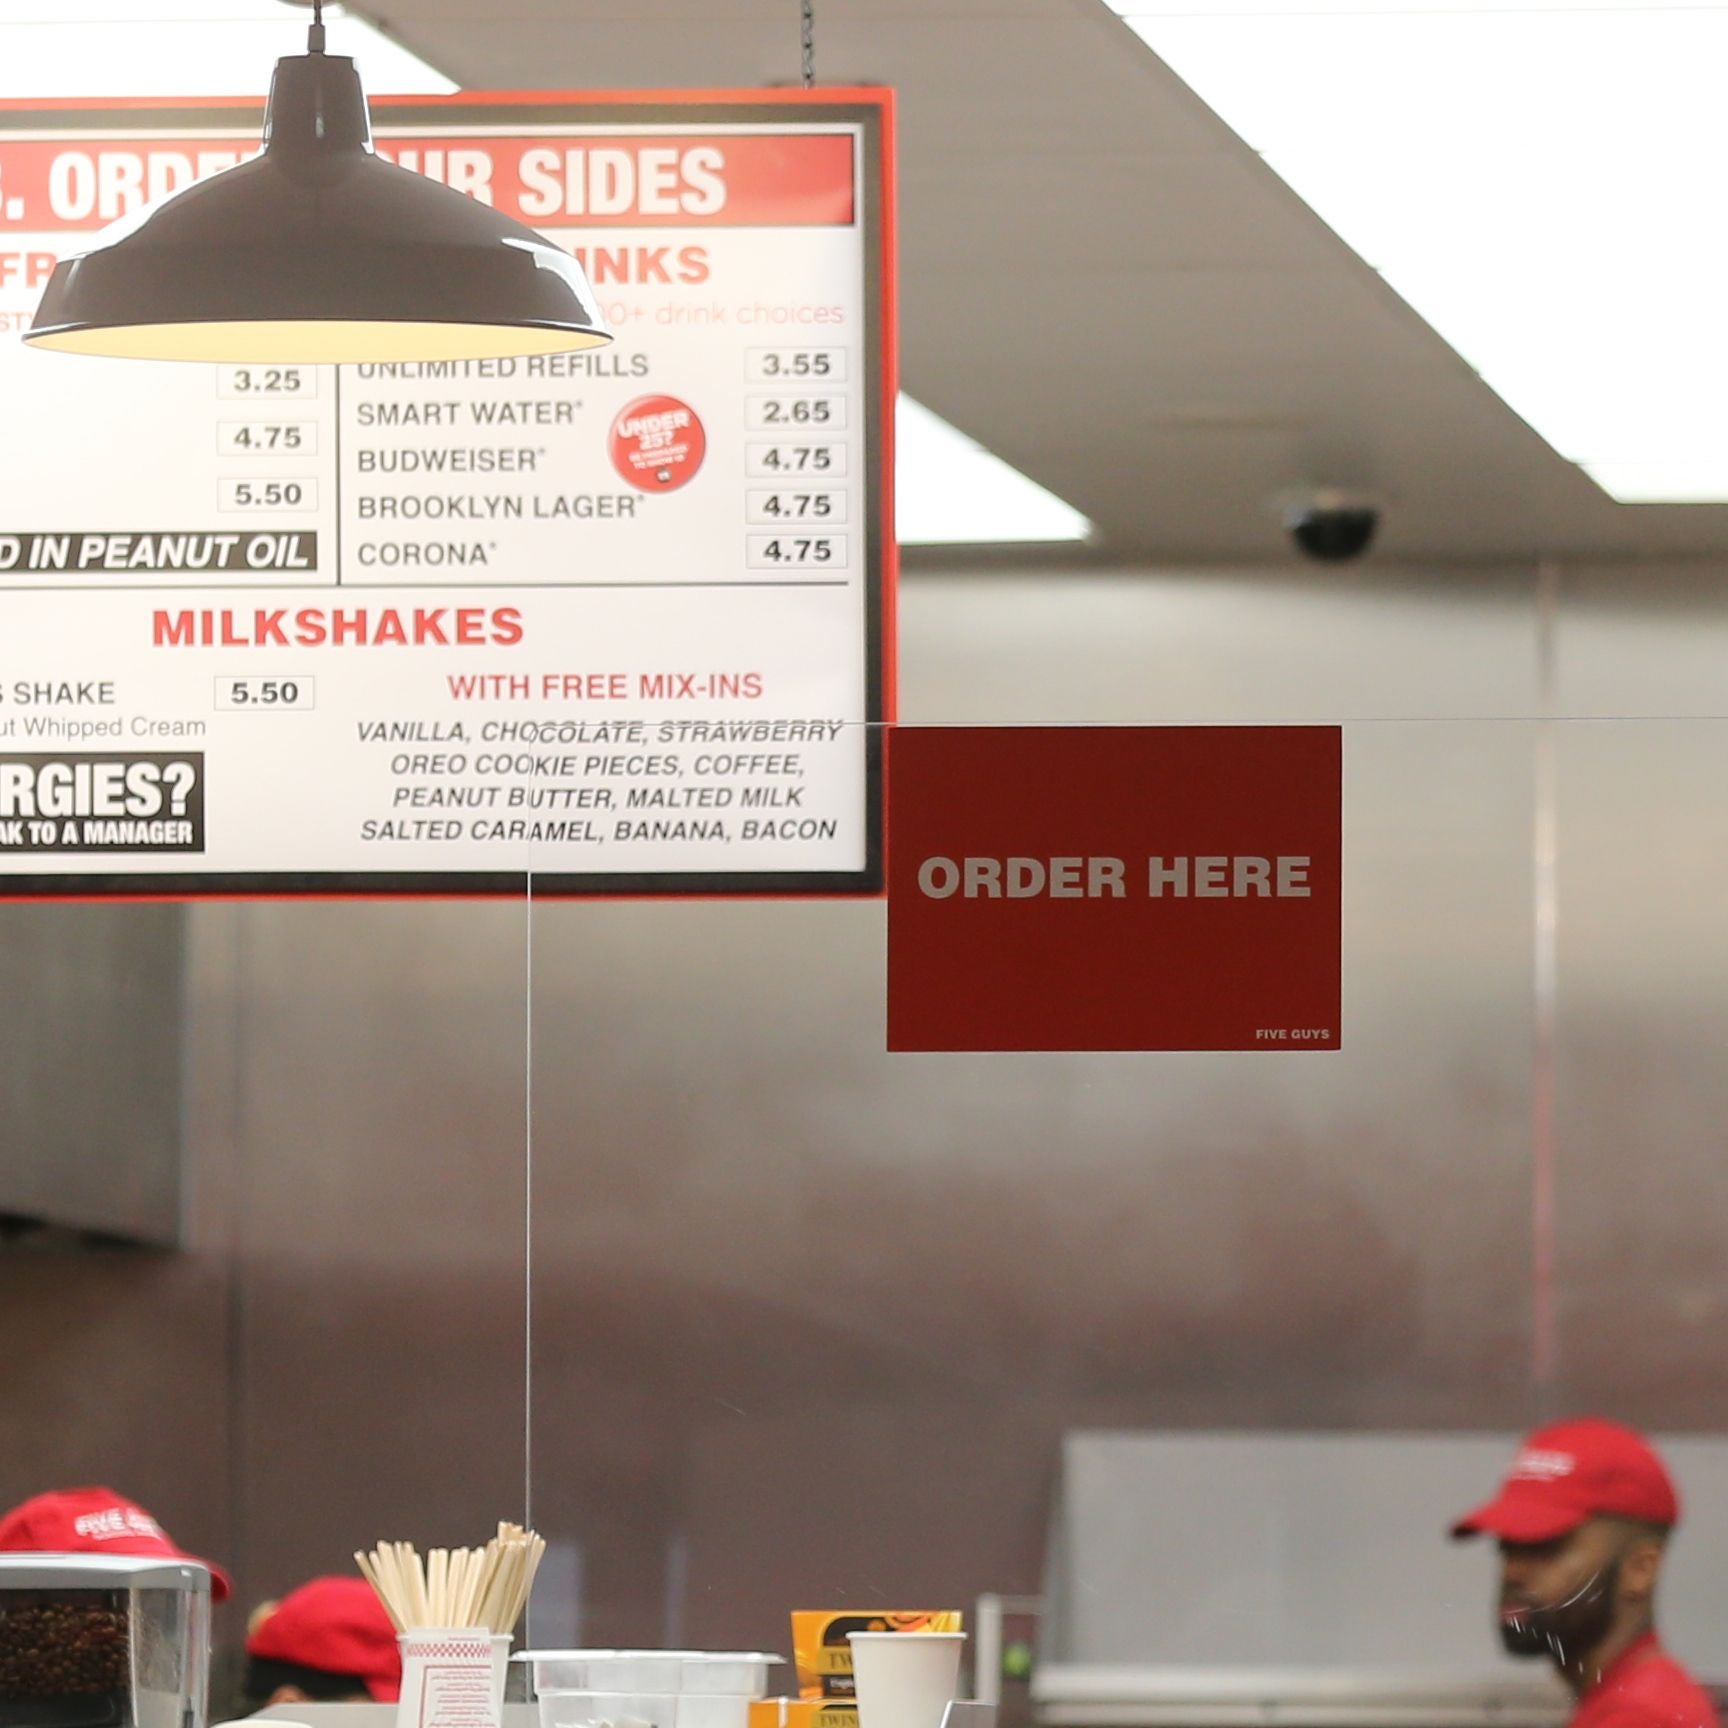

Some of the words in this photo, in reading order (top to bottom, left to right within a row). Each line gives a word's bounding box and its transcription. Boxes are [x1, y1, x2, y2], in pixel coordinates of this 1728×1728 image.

[518, 146, 727, 217] SIDES
[234, 369, 301, 392] 3.25
[234, 426, 302, 448] 4.75
[235, 483, 302, 506] 5.50
[28, 535, 71, 569] IN
[78, 534, 240, 572] PEANUT
[246, 534, 309, 572] OIL
[152, 607, 524, 647] MILKSHAKES
[13, 681, 115, 705] SHAKE
[231, 681, 299, 704] 5.50
[447, 674, 530, 700] WITH
[542, 673, 628, 700] FREE
[639, 672, 763, 699] MIX-INS
[23, 716, 123, 742] Whipped
[130, 715, 206, 737] Cream
[390, 753, 467, 775] OREO
[474, 753, 577, 777] COOKIE
[583, 754, 684, 778] PIECES,
[693, 753, 804, 777] COFFEE,
[27, 820, 57, 845] TO
[61, 820, 79, 845] A
[83, 820, 193, 845] MANAGER
[917, 856, 1127, 900] ORDER
[1148, 855, 1312, 898] HERE
[1255, 1028, 1287, 1040] FIVE
[1290, 1028, 1330, 1040] GUYS
